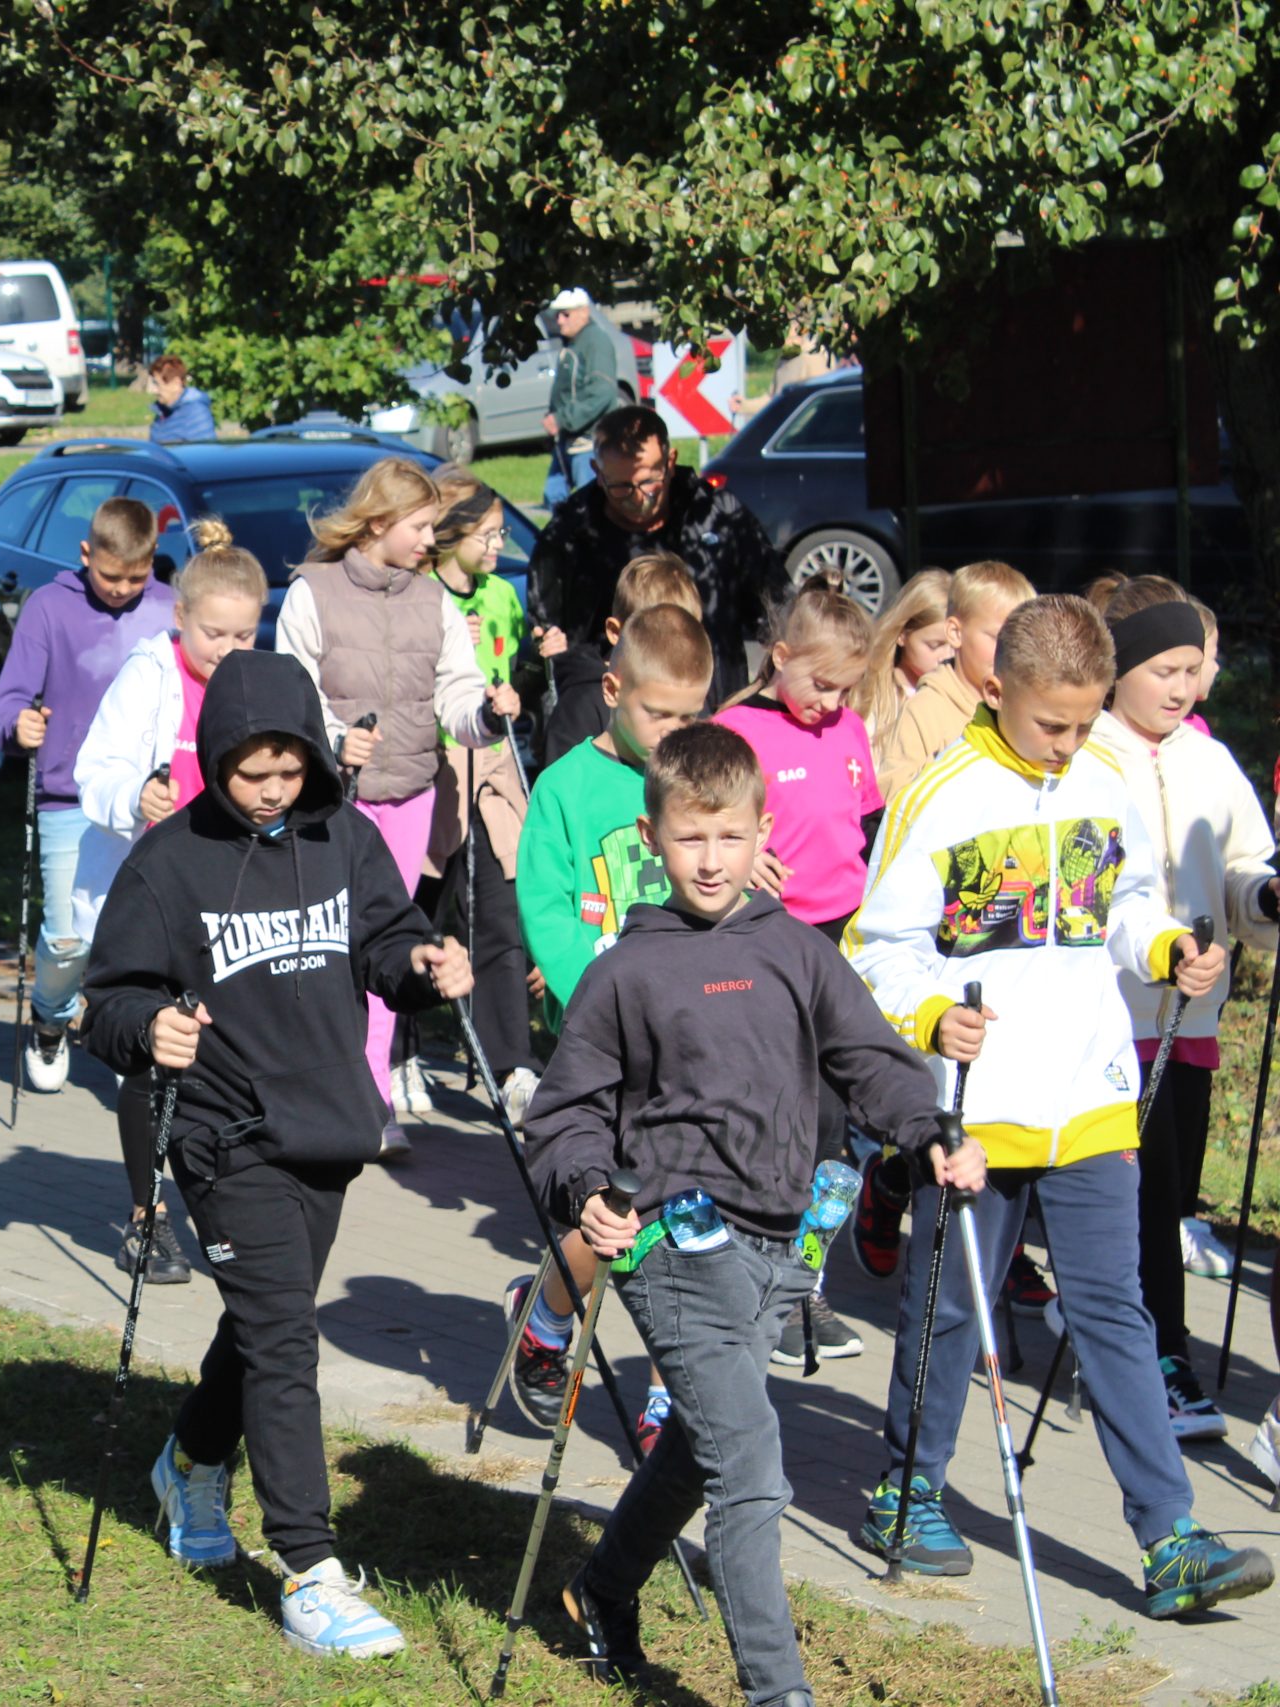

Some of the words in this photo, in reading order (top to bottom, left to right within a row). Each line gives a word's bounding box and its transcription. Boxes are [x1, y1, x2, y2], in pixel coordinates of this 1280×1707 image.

[200, 887, 350, 984] LONSDALE
[270, 954, 327, 975] LONDON
[703, 979, 753, 995] ENERGY
